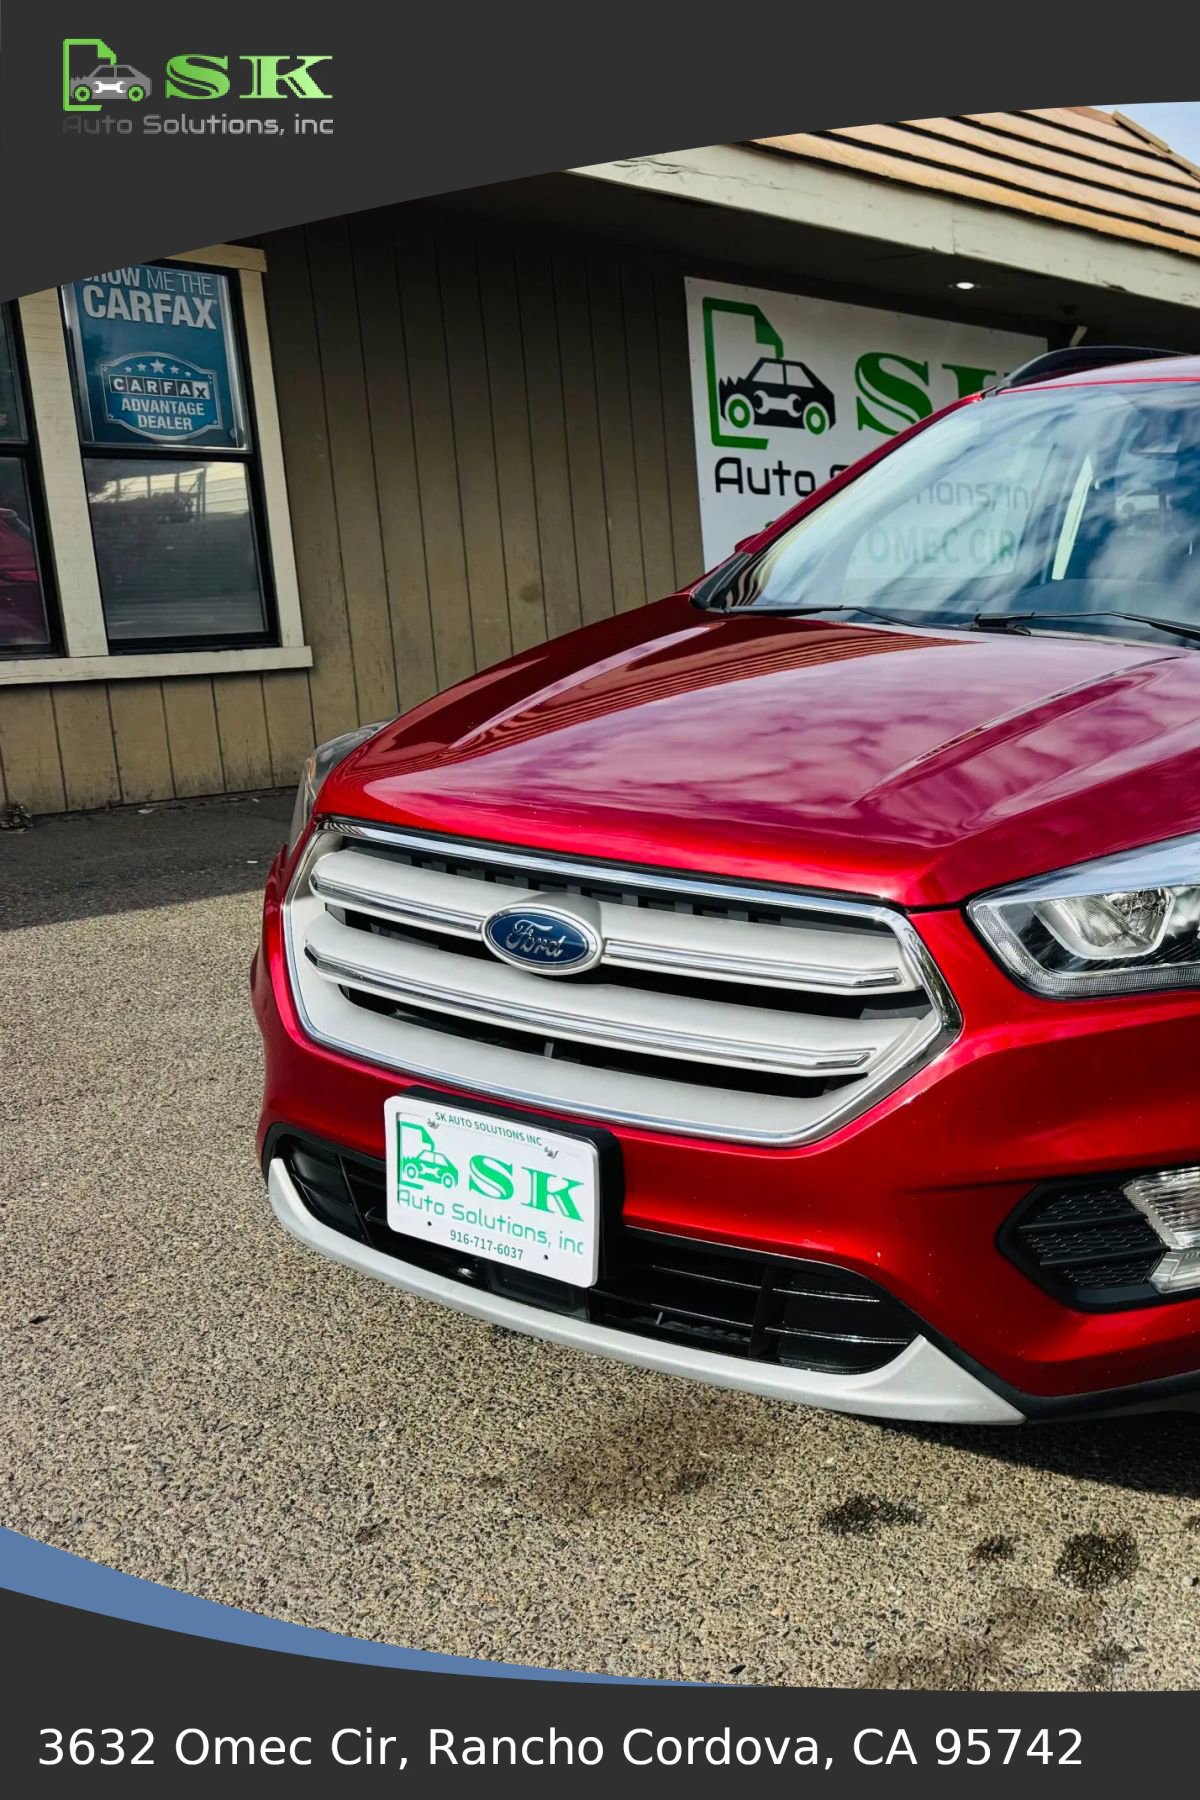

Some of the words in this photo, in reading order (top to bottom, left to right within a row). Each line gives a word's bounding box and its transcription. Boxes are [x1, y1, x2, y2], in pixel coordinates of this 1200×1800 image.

[146, 269, 176, 292] ME
[177, 273, 214, 296] THE
[82, 284, 217, 330] CARFAX
[112, 377, 208, 399] CARFAX
[121, 397, 205, 416] ADVANTAGE
[137, 414, 193, 431] DEALER
[715, 456, 817, 497] Auto
[505, 919, 567, 958] Ford
[434, 1111, 447, 1122] SK
[448, 1114, 473, 1129] AUTO
[473, 1121, 526, 1142] SOLUTIONS
[526, 1134, 543, 1147] INC
[468, 1154, 585, 1223] SK
[398, 1189, 445, 1216] Auto
[452, 1203, 553, 1249] Solutions,
[558, 1230, 585, 1256] inc
[449, 1229, 524, 1261] 916-717-6037
